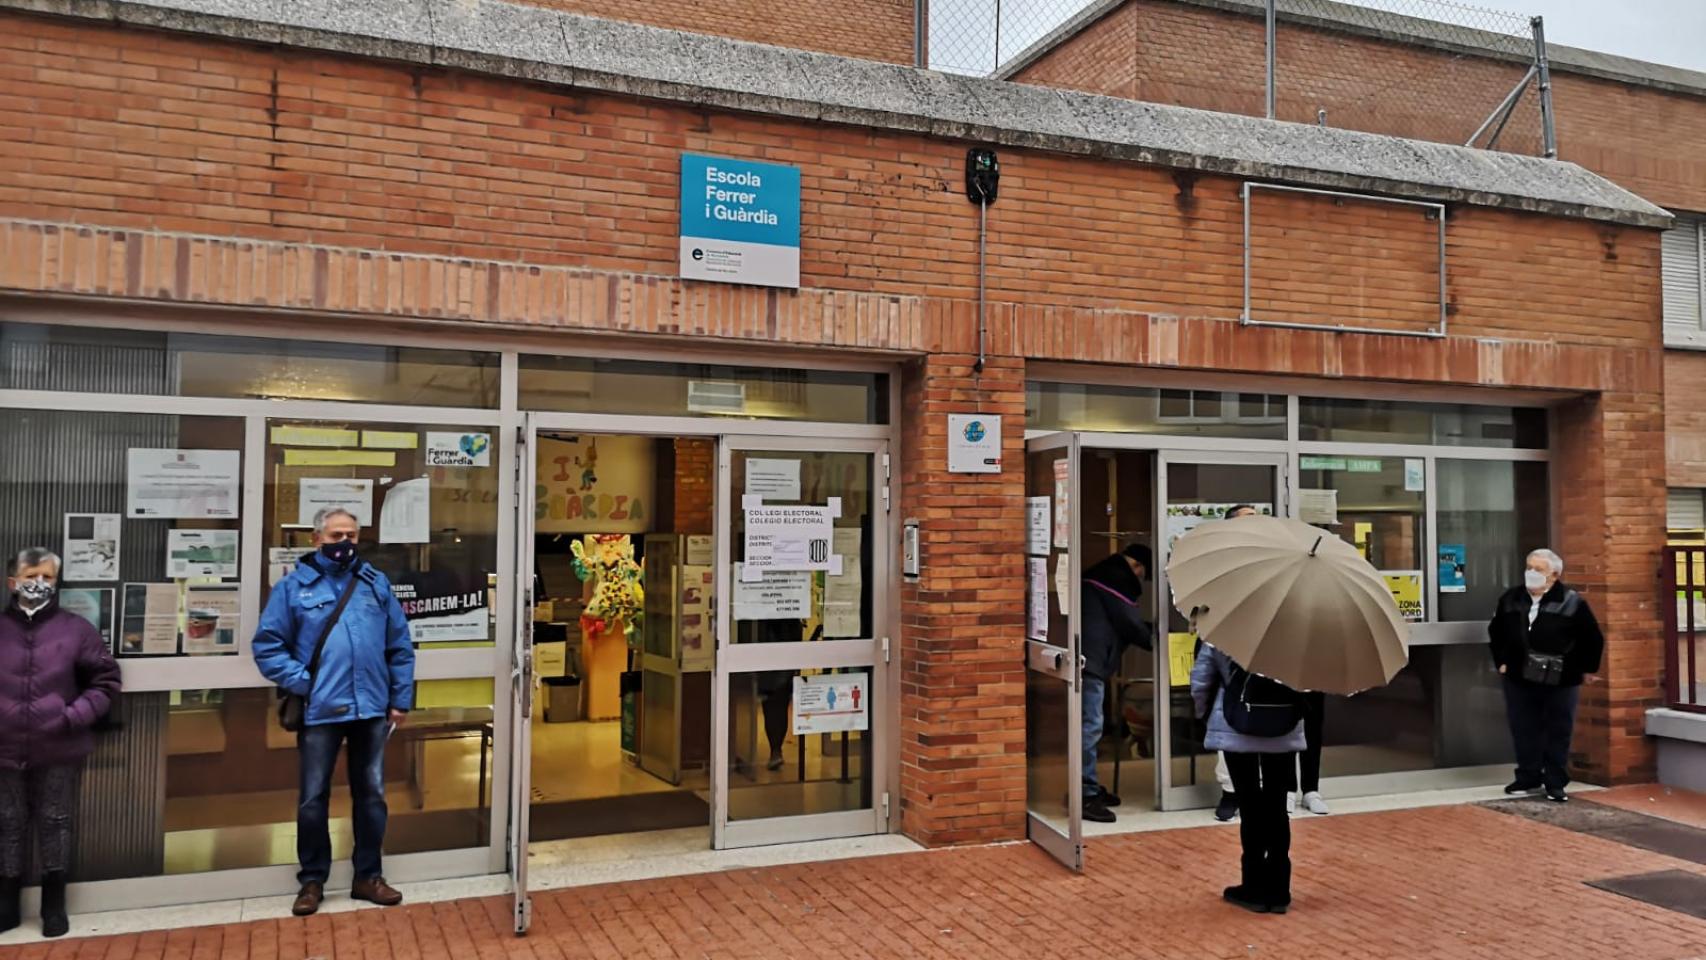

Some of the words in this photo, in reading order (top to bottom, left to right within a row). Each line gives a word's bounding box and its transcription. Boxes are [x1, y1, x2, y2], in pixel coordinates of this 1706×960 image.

[706, 166, 761, 187] Escola
[706, 185, 756, 204] Ferrer
[705, 203, 710, 218] i
[714, 204, 778, 225] Guàrdia
[428, 448, 459, 457] Ferrer
[401, 590, 483, 615] ASCAREM-LA!
[1399, 600, 1422, 609] ZONA
